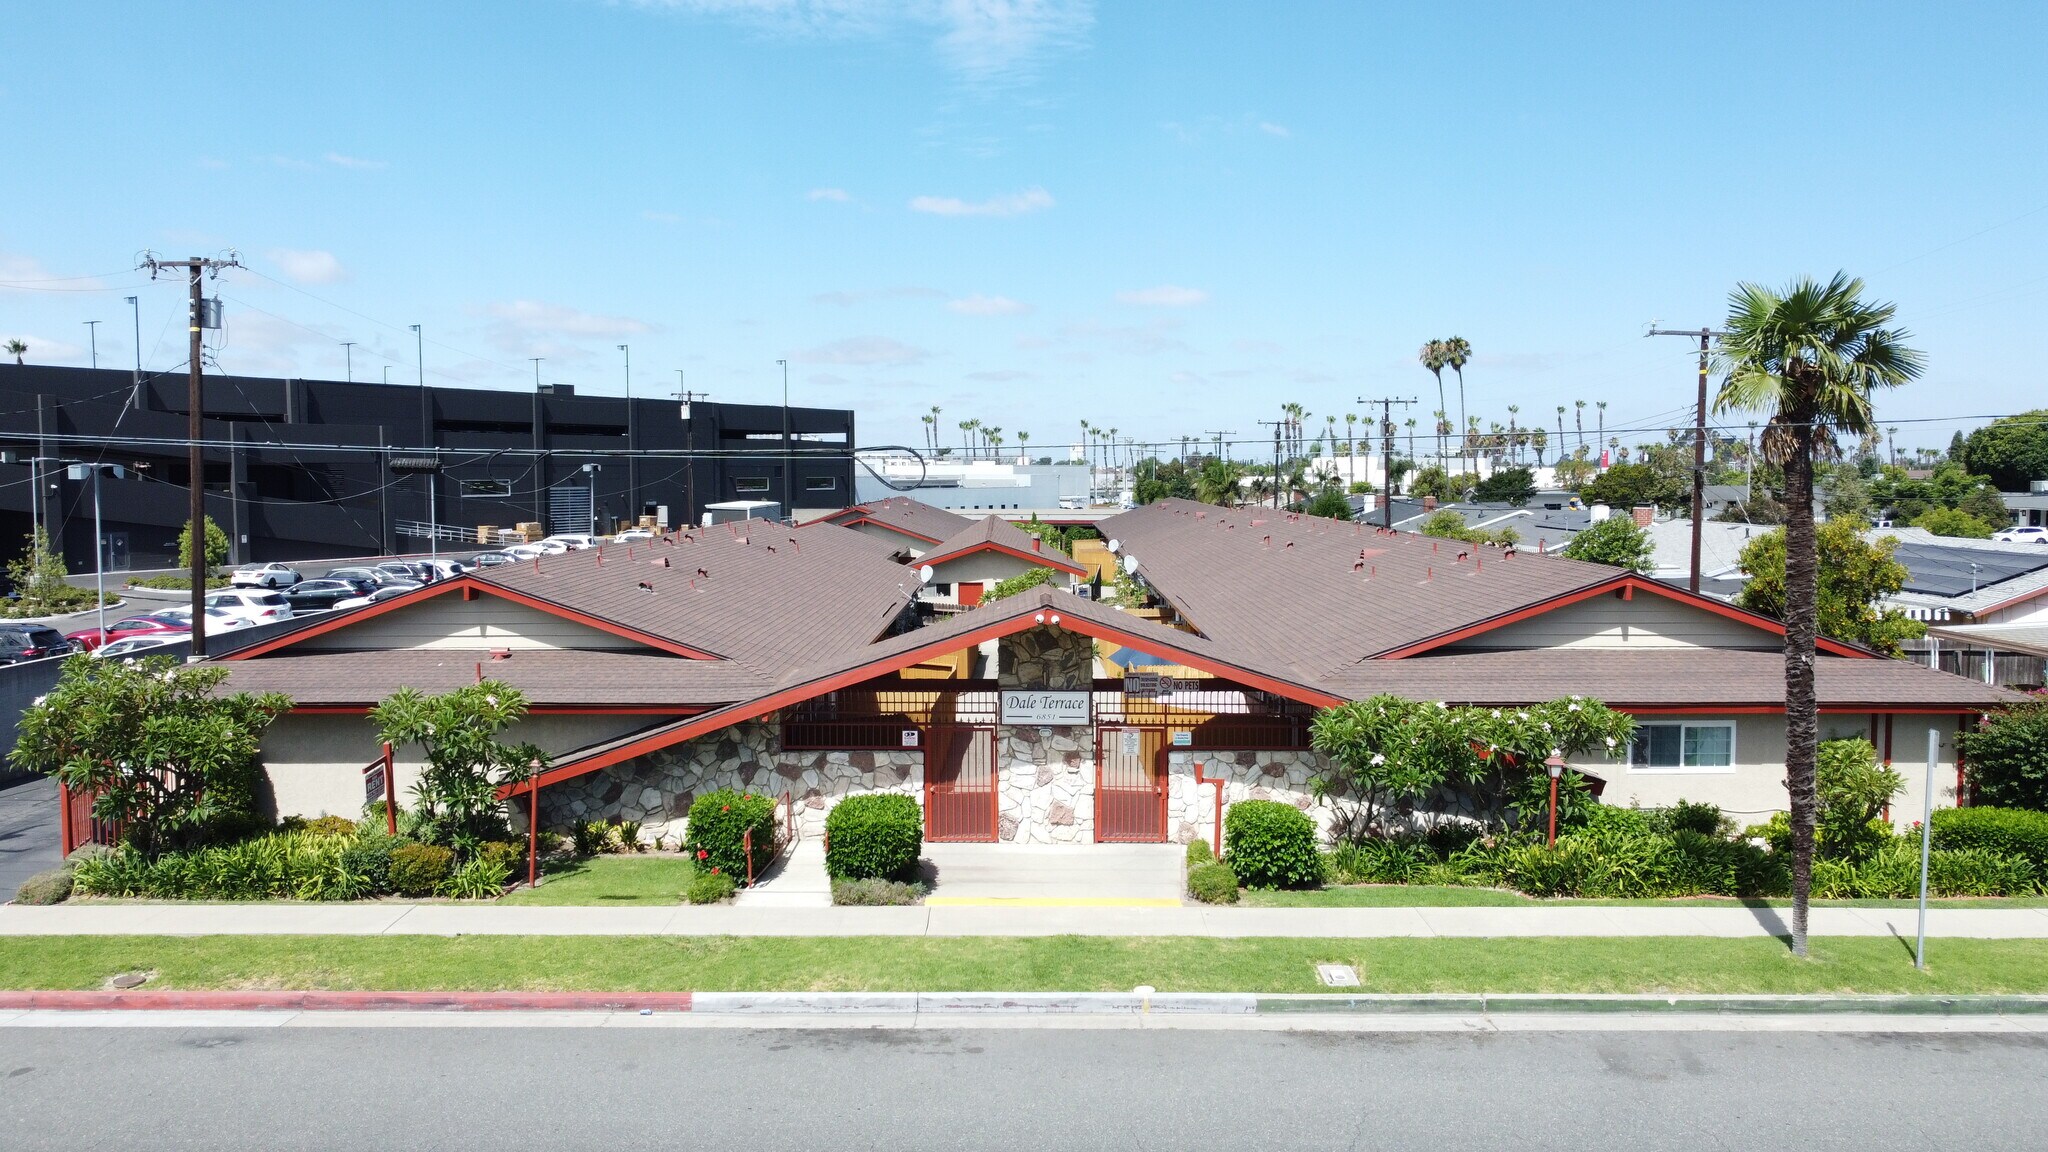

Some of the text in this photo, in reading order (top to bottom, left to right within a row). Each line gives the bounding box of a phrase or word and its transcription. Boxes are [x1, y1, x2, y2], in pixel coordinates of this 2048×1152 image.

[1125, 677, 1140, 692] NO
[1173, 681, 1199, 690] NO PETS
[1006, 694, 1084, 710] Dale Terrace
[1036, 713, 1056, 721] 6851
[367, 775, 384, 792] RENT
